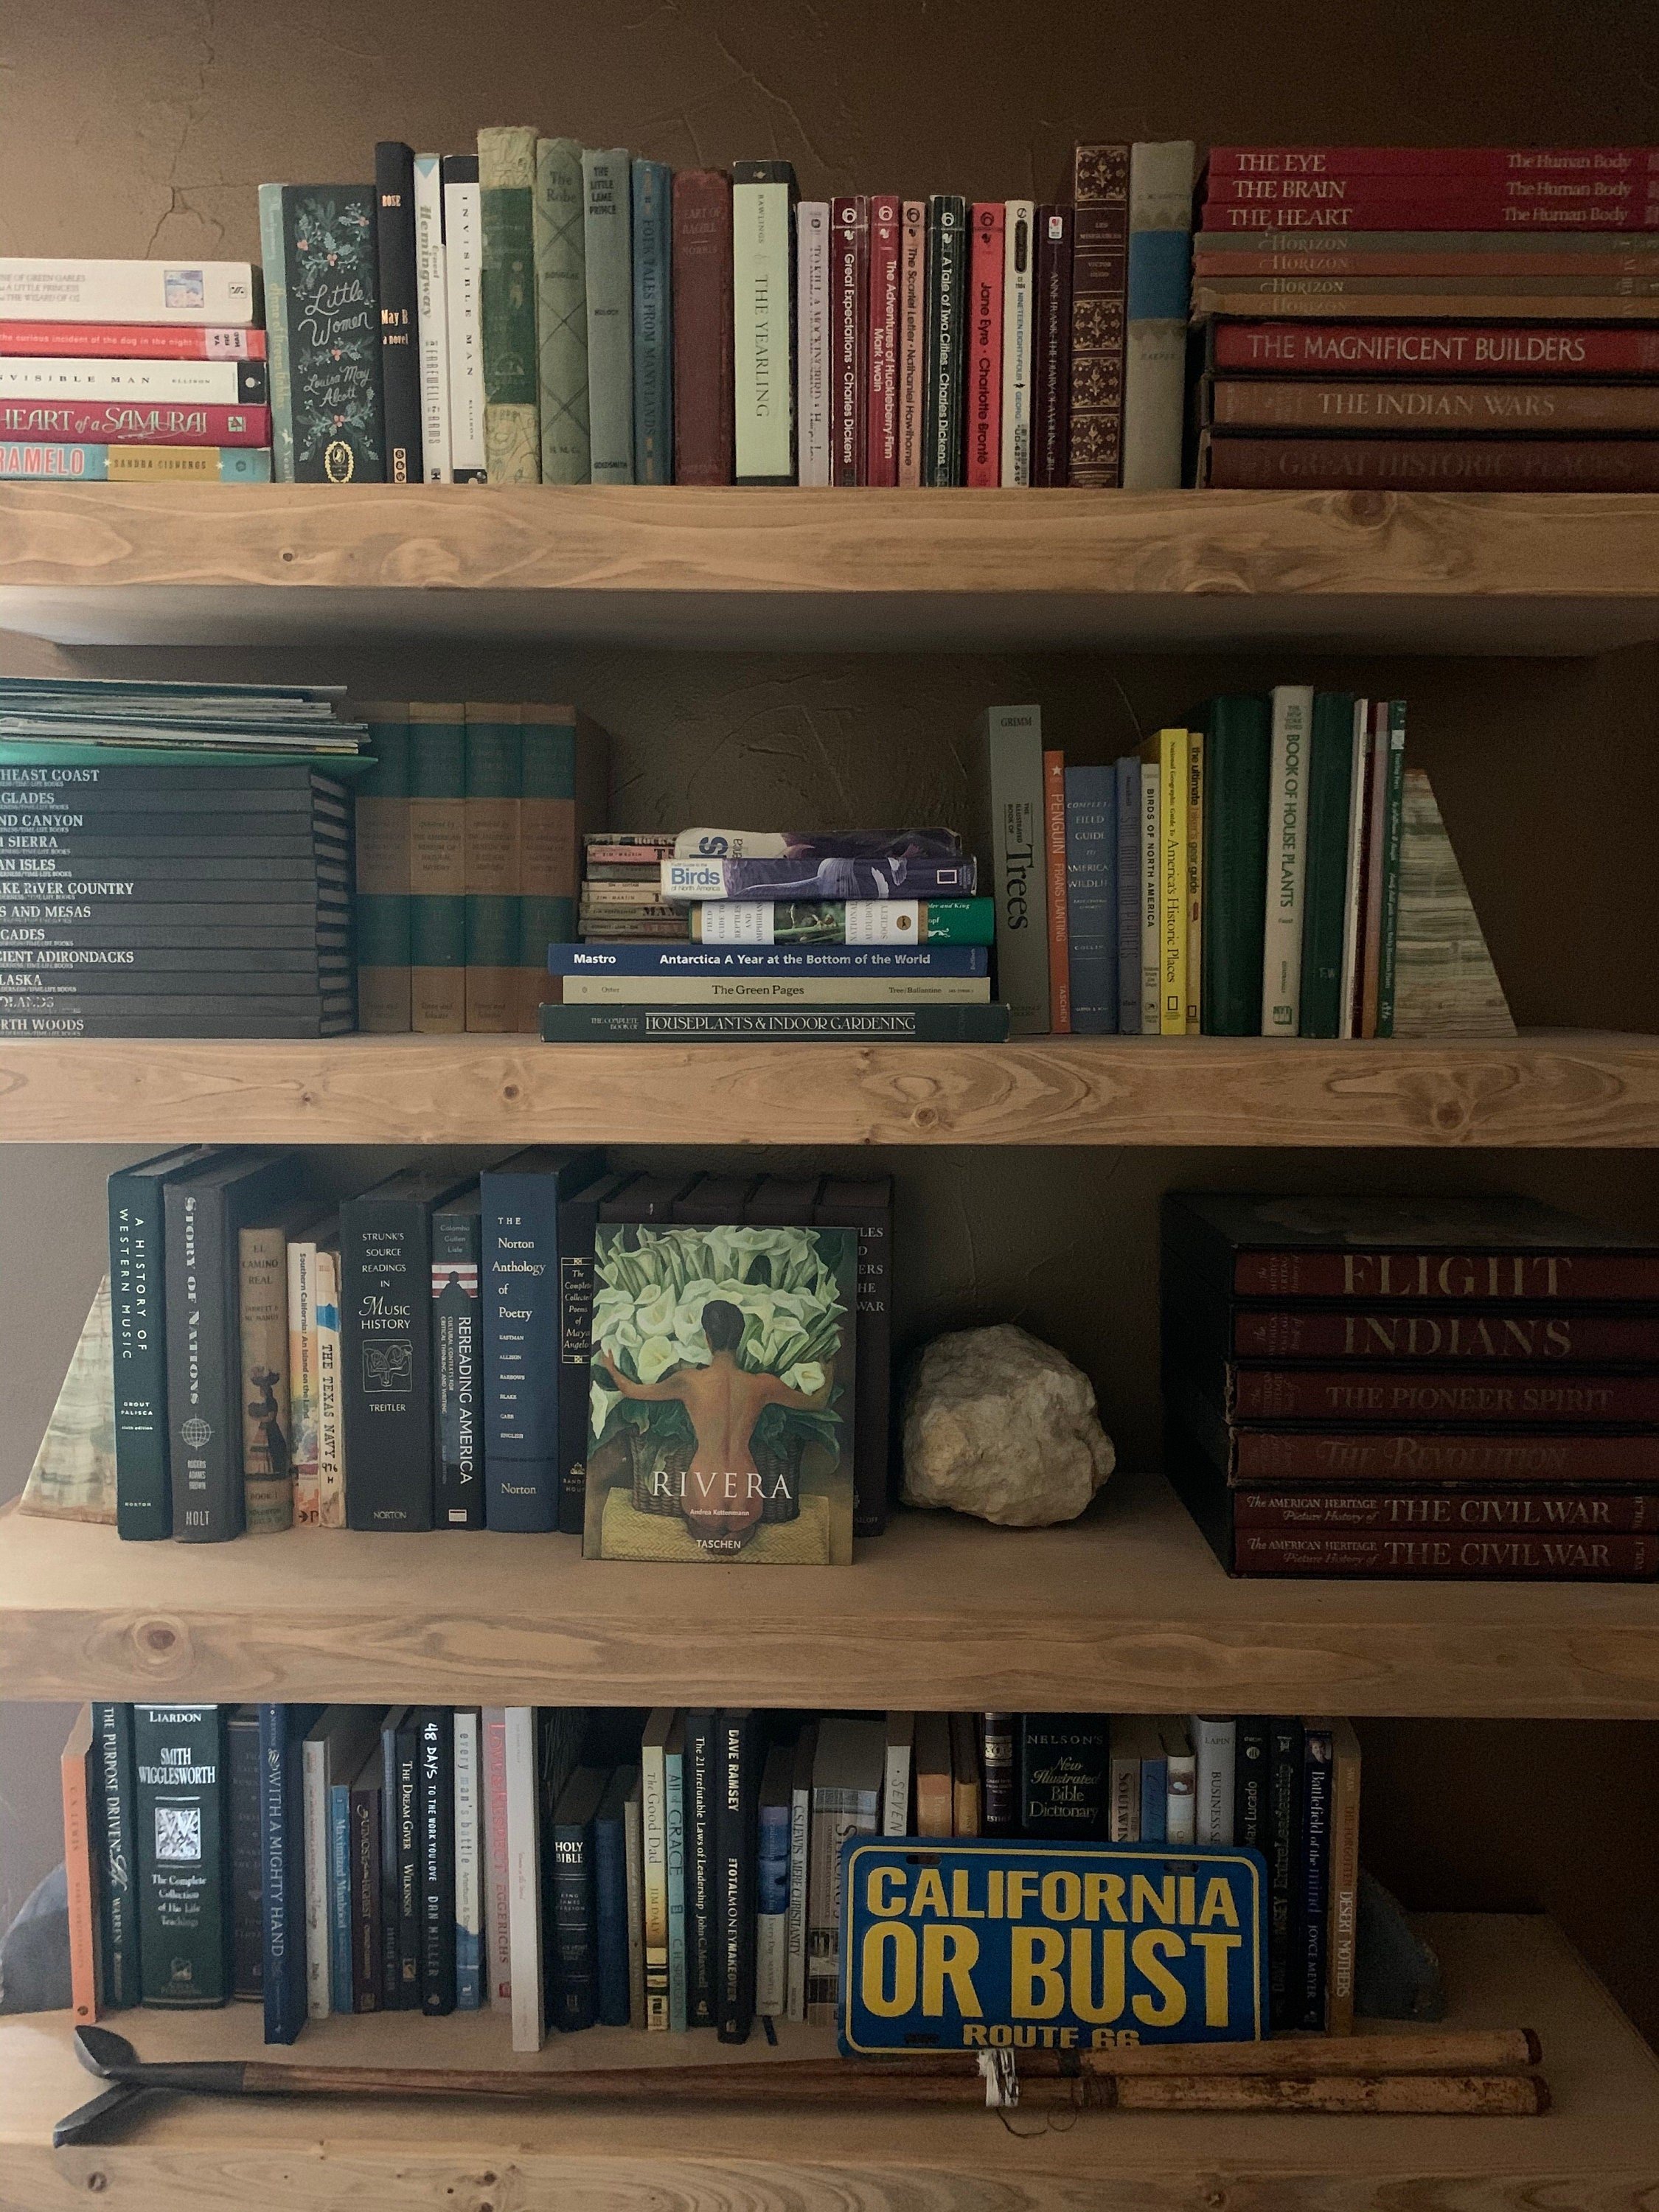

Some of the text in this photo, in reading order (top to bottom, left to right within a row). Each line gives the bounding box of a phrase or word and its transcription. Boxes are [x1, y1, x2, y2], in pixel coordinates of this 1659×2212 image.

[594, 167, 608, 176] THE
[1236, 154, 1326, 171] THE EYE
[591, 179, 614, 189] LITTLE
[1233, 181, 1346, 198] THE BRAIN
[382, 195, 401, 207] ROSE
[591, 192, 612, 203] LAME
[590, 205, 616, 215] PRINCE
[1228, 209, 1352, 226] THE HEART
[417, 206, 432, 319] Hemingway
[462, 196, 471, 318] INVISIBLE
[304, 279, 364, 316] Little
[298, 310, 375, 347] Women
[755, 278, 771, 418] THE YEARLING
[1248, 335, 1586, 361] THE MAGNIFICENT BUILDERS
[843, 254, 855, 464] Great Expectations Charles Dickens
[873, 328, 884, 392] Mark Twain
[305, 366, 372, 392] Louisa May
[976, 282, 991, 464] Jane Eyre Charlotte Brontë
[320, 386, 358, 407] Alcott
[74, 416, 90, 434] of
[91, 420, 100, 431] a
[101, 407, 207, 435] SAMURAI
[1001, 717, 1032, 727] GRIMM
[1286, 734, 1300, 775] BOOK
[52, 769, 100, 782] COAST
[1284, 779, 1298, 798] OF
[1, 792, 55, 804] GLADES
[1051, 794, 1066, 855] PENGUIN
[1283, 803, 1297, 849] HOUSE
[8, 836, 58, 848] SIERRA
[671, 868, 720, 885] Birds
[1281, 853, 1295, 908] PLANTS
[1006, 844, 1034, 931] Trees
[12, 906, 91, 918] AND MESAS
[1167, 839, 1180, 983] America's Historic Places
[574, 954, 616, 964] Mastro
[660, 954, 931, 965] Antarctica A Year at the Bottom of the World
[712, 985, 804, 997] The Green Pages
[645, 1016, 917, 1031] HOUSEPLANTS & INDOOR GARDENING
[498, 1217, 521, 1225] THE
[362, 1232, 405, 1242] STRUNK'S
[498, 1238, 535, 1250] Norton
[366, 1248, 402, 1256] SOURCE
[361, 1265, 407, 1273] READINGS
[492, 1260, 547, 1276] Anthology
[573, 1270, 585, 1279] The
[1342, 1255, 1573, 1297] FLIGHT
[119, 1208, 131, 1359] WESTERN MUSIC
[136, 1239, 147, 1318] HISTORY
[380, 1280, 391, 1288] IN
[498, 1283, 510, 1295] of
[184, 1197, 201, 1405] STORY OF NATIONS
[569, 1305, 588, 1314] Poems
[855, 1301, 885, 1312] WAR
[499, 1308, 533, 1322] Poetry
[361, 1319, 411, 1330] HISTORY
[136, 1330, 147, 1352] OF
[566, 1329, 590, 1340] Maya
[1343, 1317, 1572, 1357] INDIANS
[321, 1344, 335, 1459] THE TEXAS NAVY
[369, 1404, 406, 1413] TREITLER
[458, 1316, 473, 1485] REREADING AMERICA
[501, 1483, 537, 1495] Norton
[653, 1470, 793, 1500] RIVERA
[185, 1511, 210, 1527] HOLT
[1385, 1500, 1611, 1524] THE CIVIL WAR
[696, 1540, 741, 1549] TASCHEN
[1385, 1543, 1611, 1567] THE CIVIL WAR
[149, 1711, 201, 1722] LIARDON
[1026, 1735, 1104, 1745] NELSON'S
[1205, 1736, 1230, 1745] LAPIN
[159, 1747, 192, 1765] SMITH
[1053, 1756, 1082, 1770] New
[138, 1765, 216, 1785] WIGGLESWORTH
[728, 1729, 740, 1812] DAVE RAMSEY
[1030, 1770, 1102, 1784] Illustrated
[424, 1722, 439, 1881] 48 DAYS TO THE WORK YOU LOVE
[1051, 1785, 1085, 1801] Bible
[1211, 1771, 1222, 1832] BUSINESS
[402, 1761, 414, 1850] THE DREAM GIVER
[891, 1779, 906, 1835] SEVEN
[1029, 1801, 1100, 1823] Dictionary
[647, 1773, 661, 1864] The Good Dad
[555, 1842, 583, 1852] HOLY
[555, 1853, 583, 1863] BIBLE
[403, 1863, 414, 1917] WILKINSON
[867, 1866, 1240, 1927] CALIFORNIA
[495, 1884, 509, 1964] EGGERICHS
[1336, 1891, 1354, 1997] DESERT MOTHERS
[1307, 1924, 1318, 1998] JOYCE MEYER
[861, 1921, 1243, 2028] OR BUST
[962, 2024, 1140, 2050] ROUTE 66
